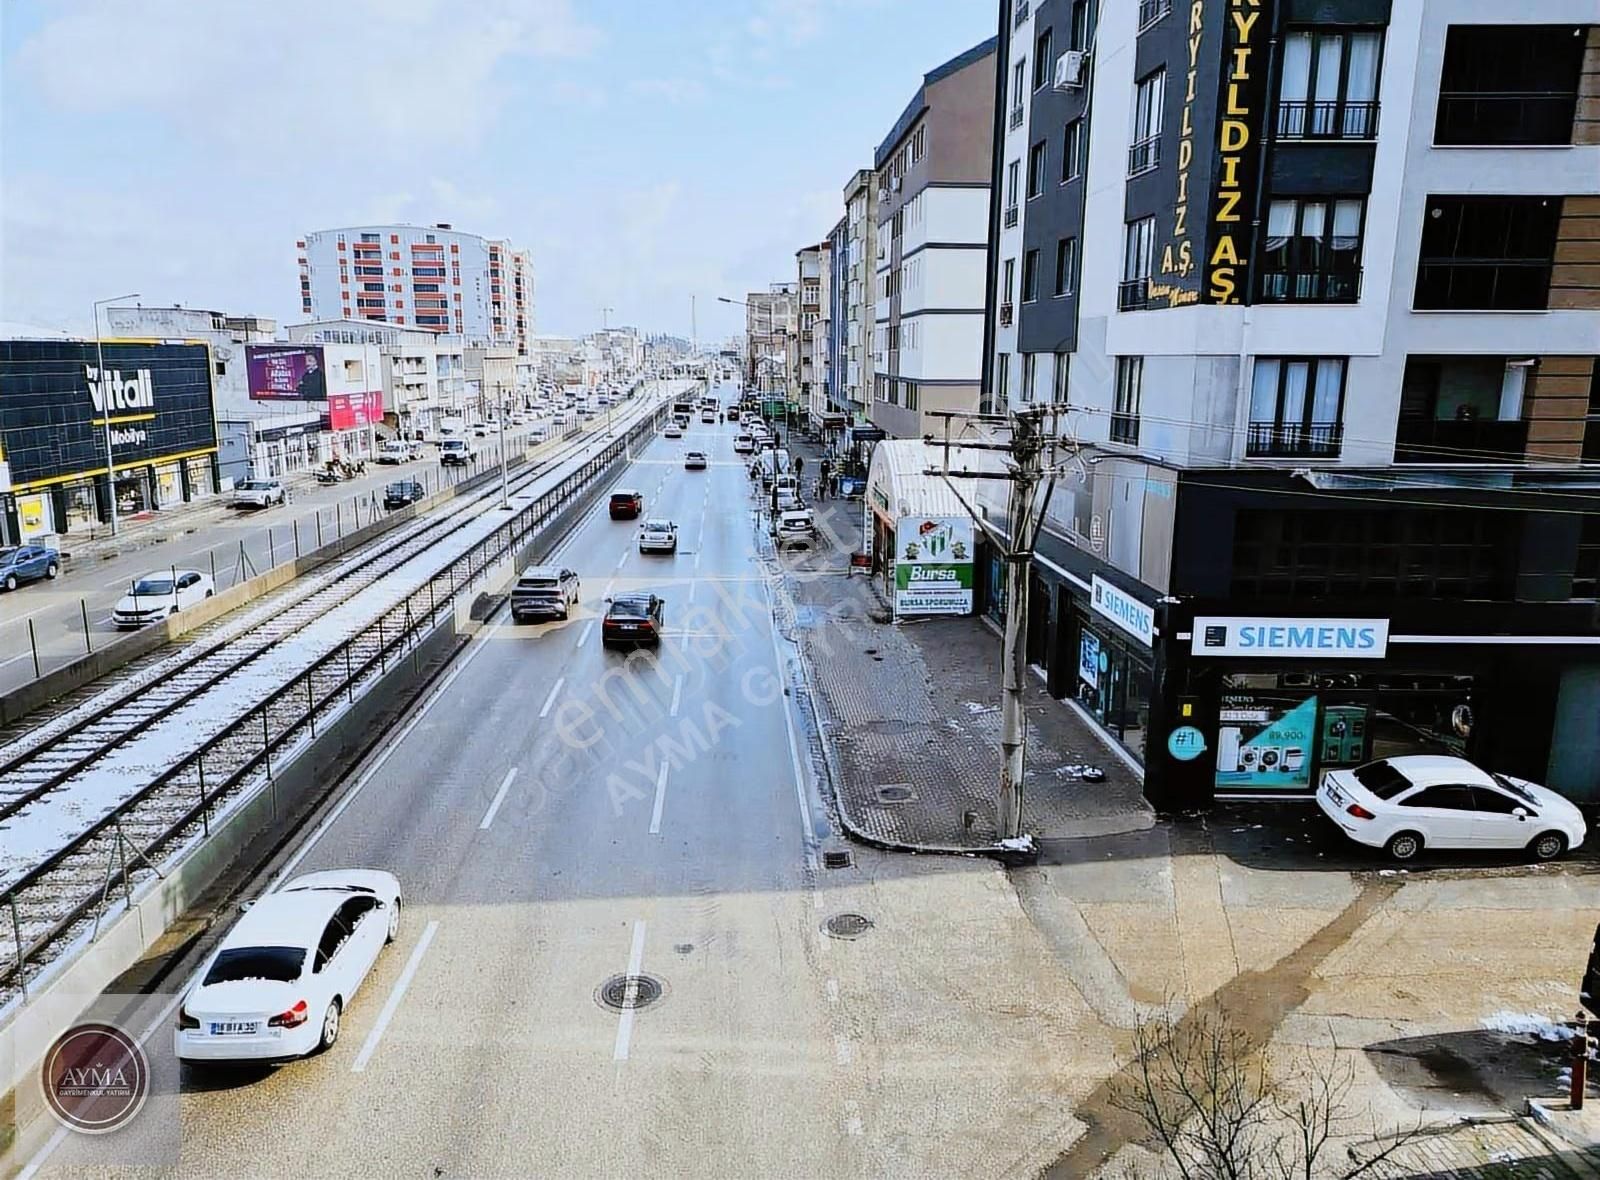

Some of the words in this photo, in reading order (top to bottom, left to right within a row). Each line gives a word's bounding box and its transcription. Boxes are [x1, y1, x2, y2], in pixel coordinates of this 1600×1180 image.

[1215, 0, 1261, 222] YILDIZ
[85, 364, 99, 381] by
[110, 428, 146, 446] Mobilya
[910, 565, 957, 580] Bursa
[1105, 589, 1151, 635] SIEMENS
[1238, 626, 1376, 649] SIEMENS
[1175, 731, 1195, 746] #1
